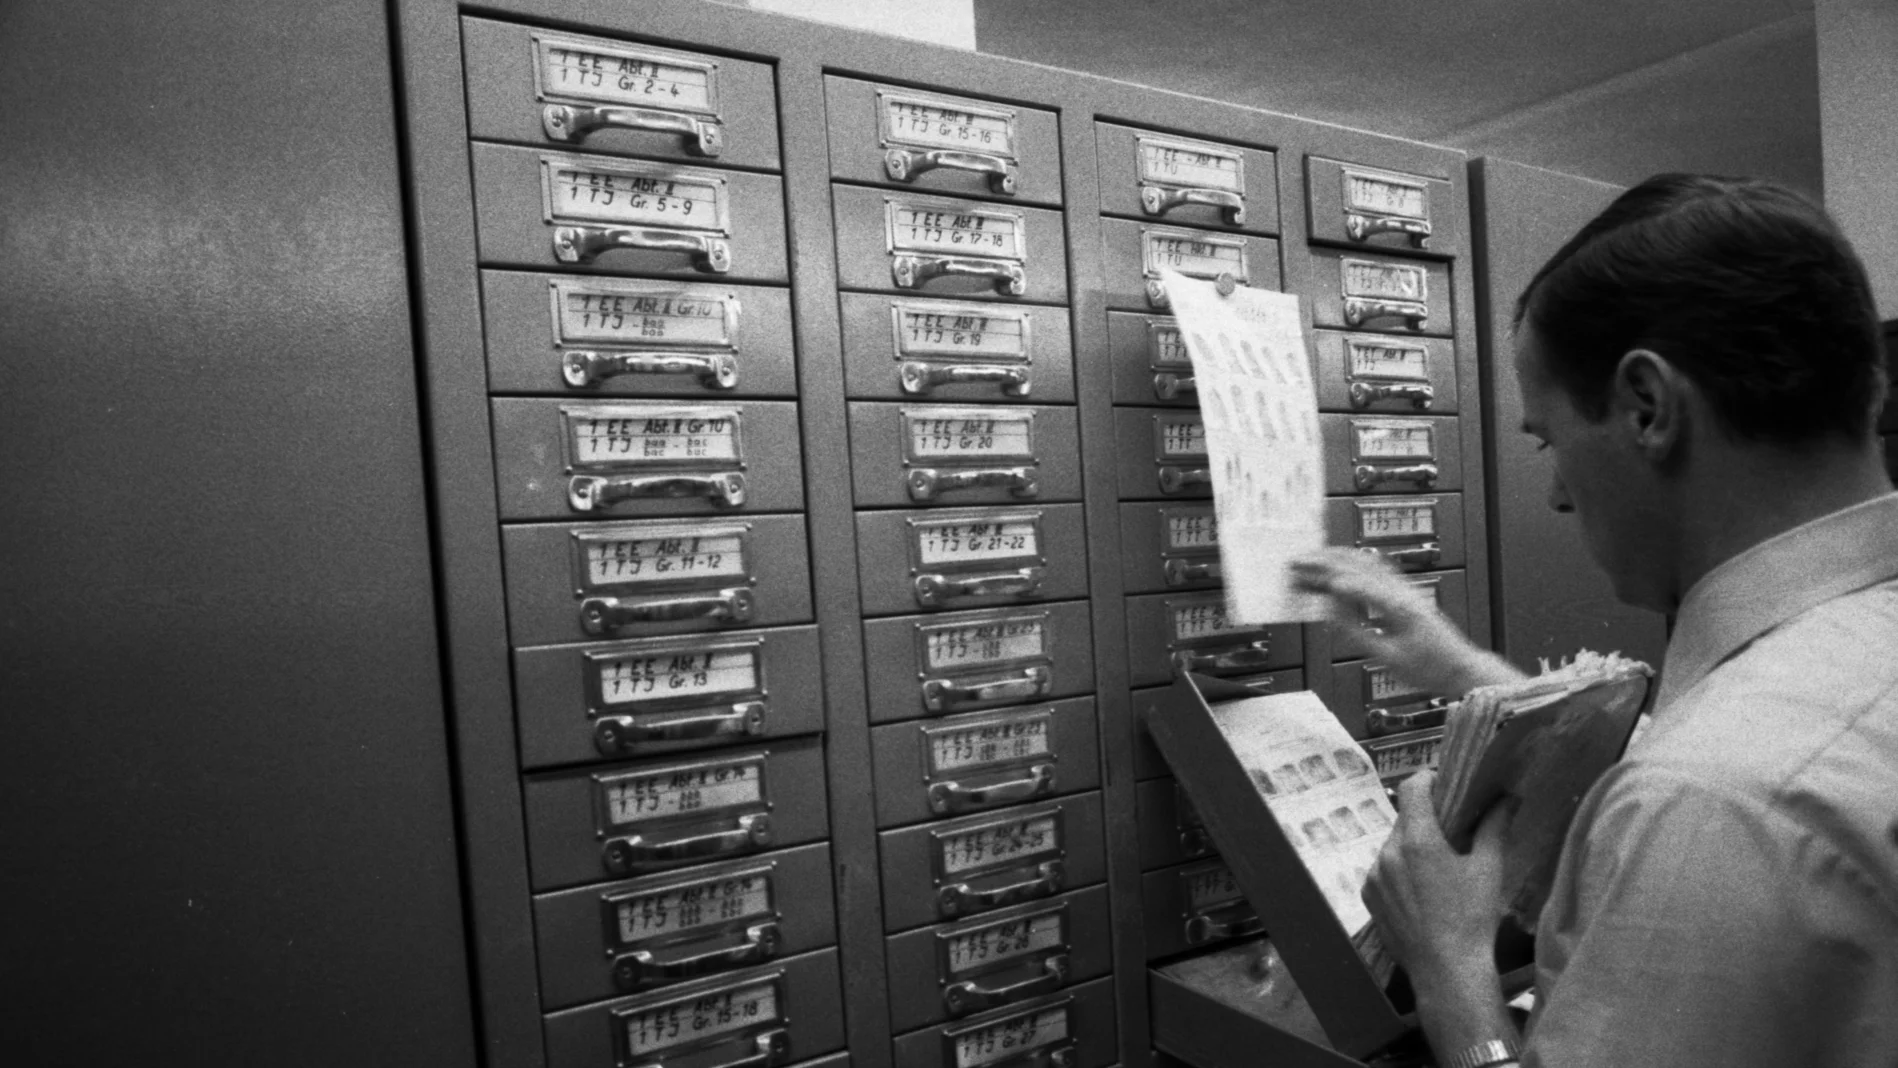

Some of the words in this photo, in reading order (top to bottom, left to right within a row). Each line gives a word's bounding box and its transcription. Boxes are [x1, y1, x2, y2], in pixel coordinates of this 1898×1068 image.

[562, 69, 568, 82] 1
[644, 79, 654, 94] 2
[670, 83, 680, 97] 4
[898, 116, 904, 129] 1
[571, 187, 578, 200] 1
[656, 197, 667, 212] 5
[683, 200, 693, 215] 9
[911, 212, 918, 224] 1
[912, 228, 918, 240] 1
[583, 295, 590, 309] 1
[583, 313, 590, 328] 1
[913, 314, 920, 326] 1
[912, 328, 919, 342] 1
[590, 419, 599, 434] 1
[921, 420, 928, 433] 1
[1169, 424, 1175, 436] 1
[590, 438, 598, 453] 1
[920, 436, 927, 449] 1
[977, 436, 993, 449] 20
[1168, 438, 1175, 450] 1
[1176, 531, 1182, 543] 1
[601, 543, 608, 558] 1
[928, 540, 935, 552] 1
[601, 560, 608, 576] 1
[1180, 621, 1186, 634] 1
[935, 646, 942, 660] 1
[615, 661, 623, 677] 1
[613, 679, 621, 695] 1
[693, 671, 707, 687] 13
[941, 748, 948, 763] 1
[619, 798, 627, 814] 1
[950, 851, 957, 866] 1
[628, 918, 636, 934] 1
[954, 951, 961, 965] 1
[638, 1031, 647, 1046] 1
[963, 1046, 970, 1060] 1
